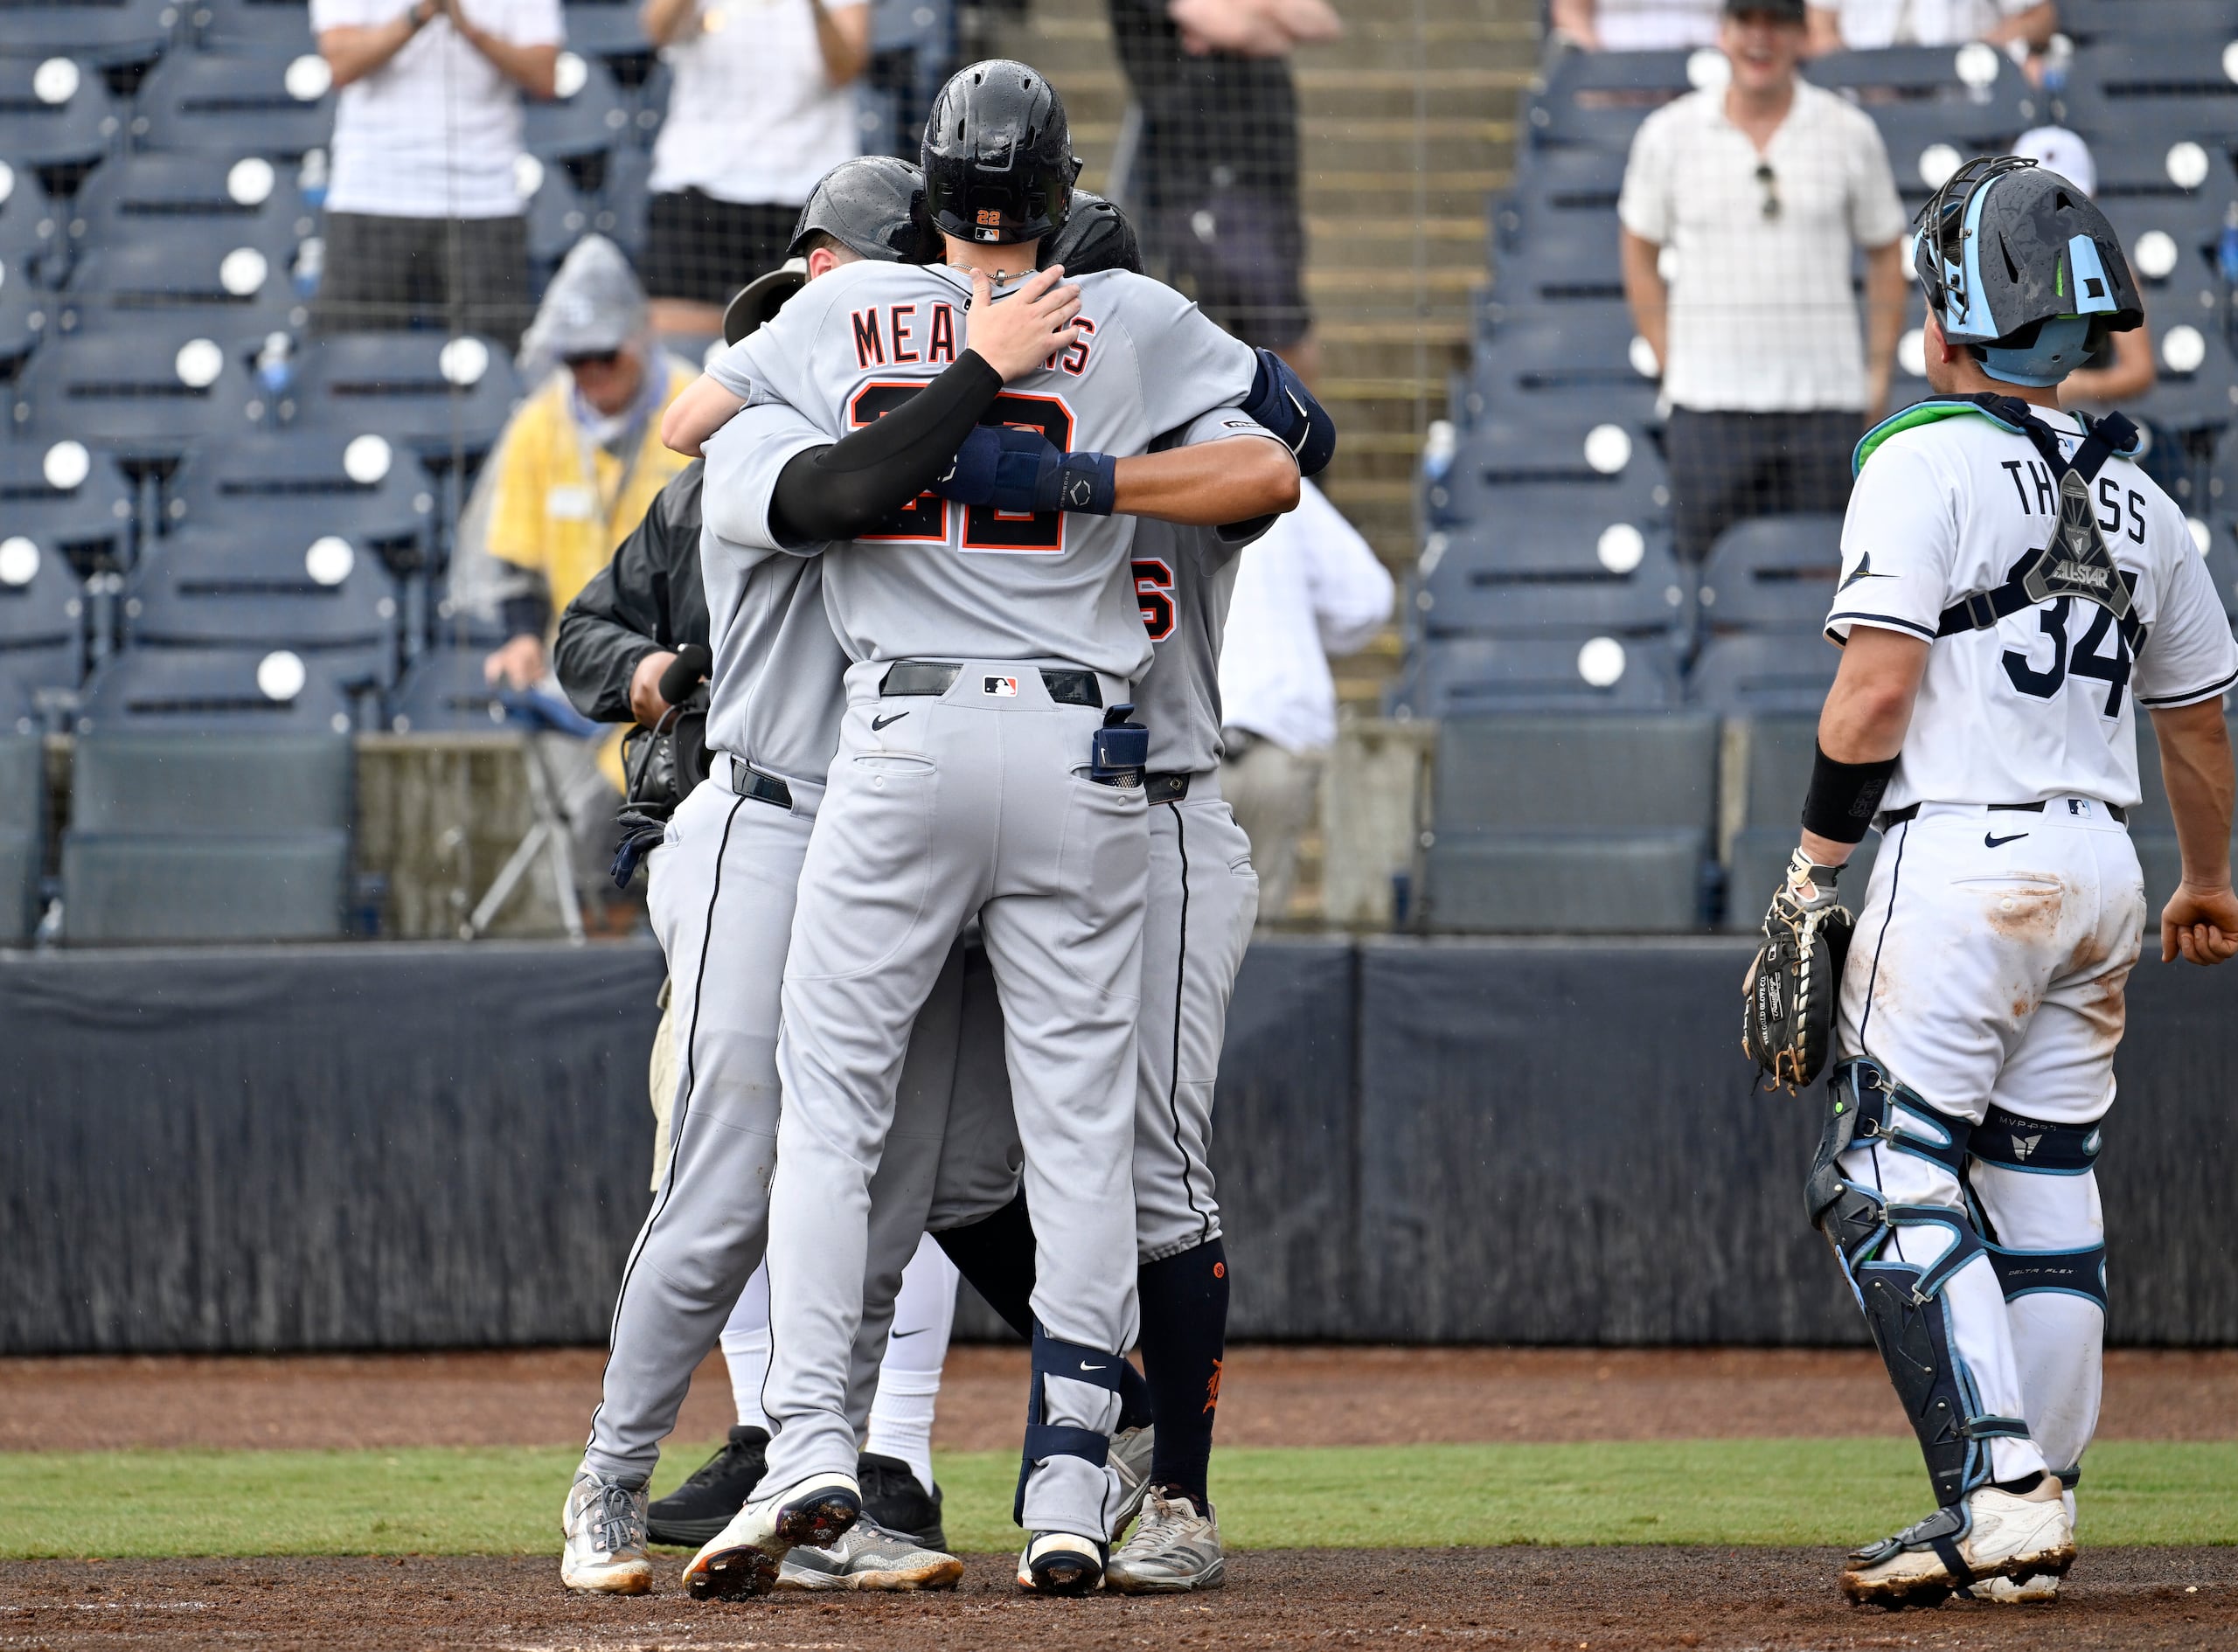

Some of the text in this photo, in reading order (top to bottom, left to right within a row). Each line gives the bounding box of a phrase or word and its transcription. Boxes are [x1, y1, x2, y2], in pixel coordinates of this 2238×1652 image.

[977, 210, 1001, 226] 22
[850, 302, 1095, 377] MEAS
[2001, 460, 2146, 545] THSS
[2052, 559, 2109, 588] ALL-STAR
[2000, 546, 2141, 723] 34
